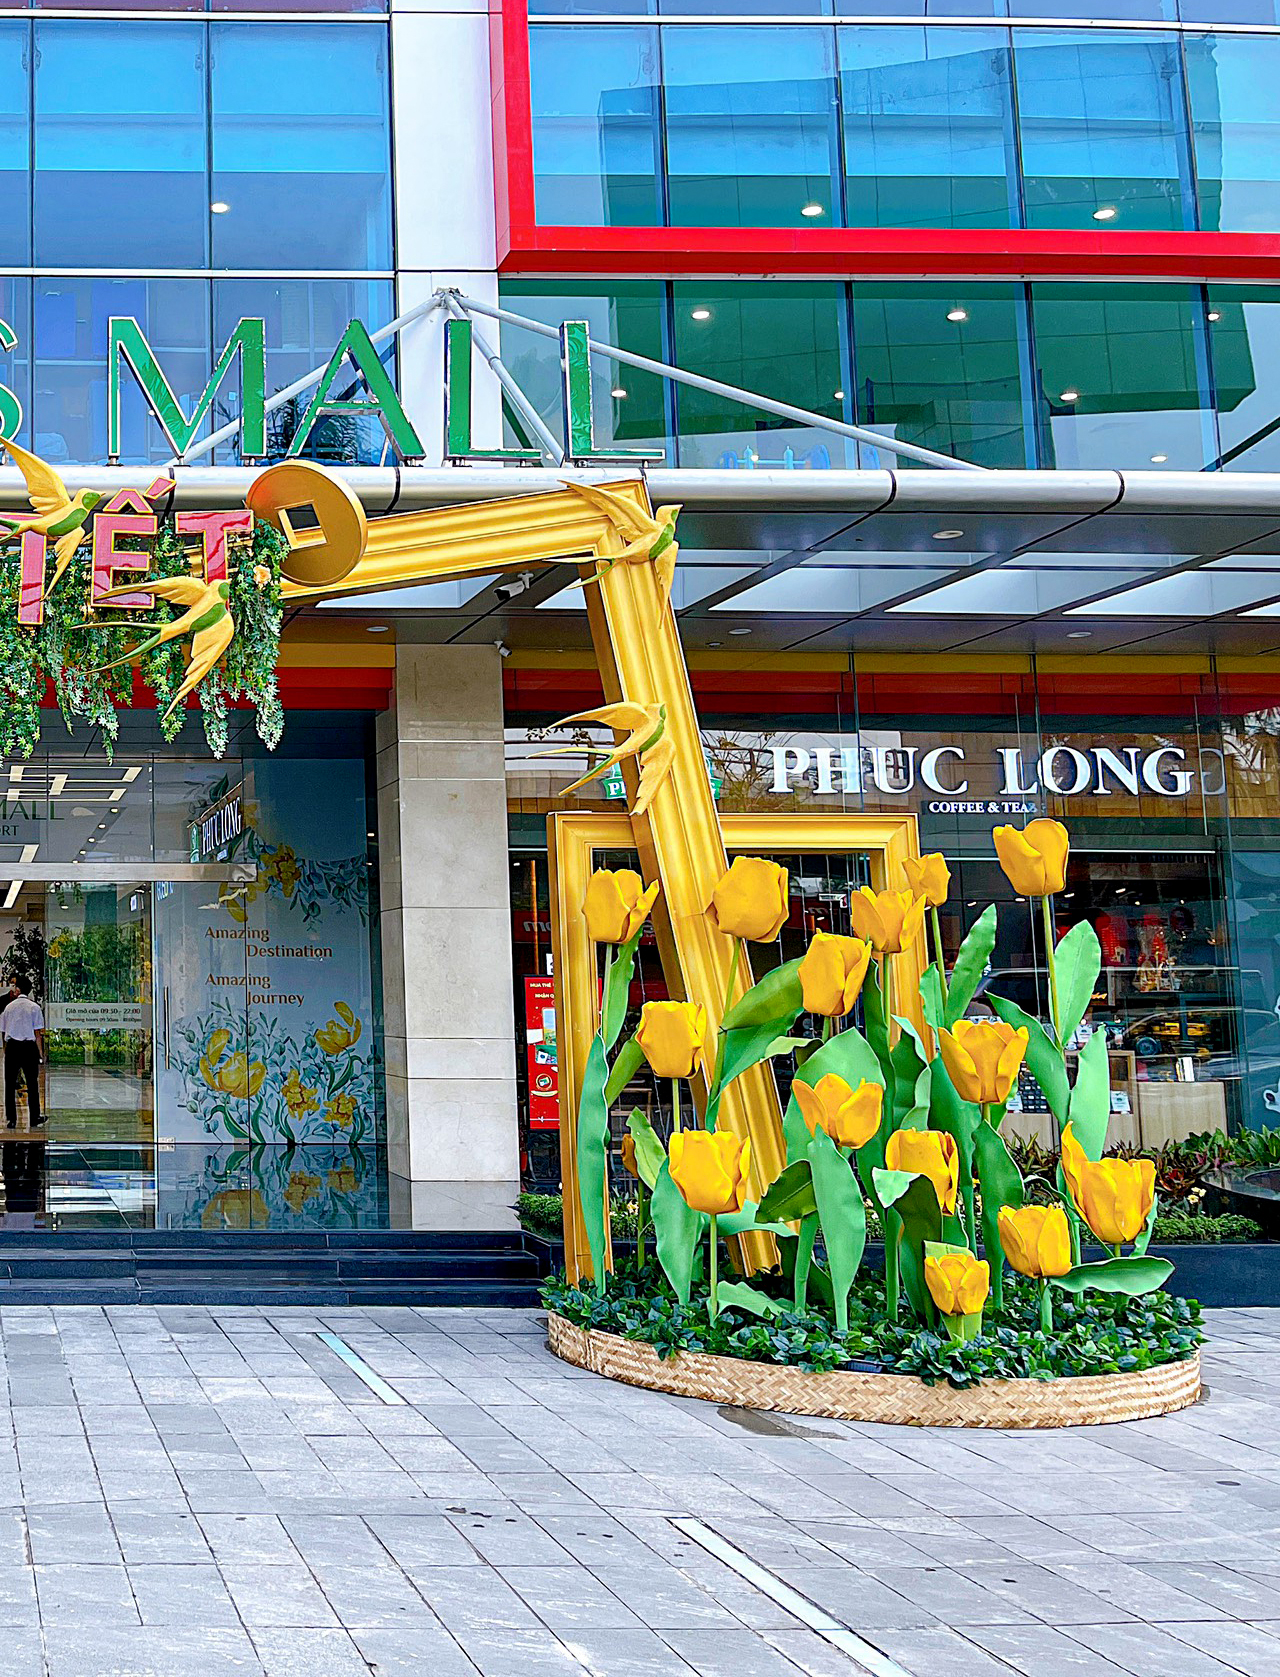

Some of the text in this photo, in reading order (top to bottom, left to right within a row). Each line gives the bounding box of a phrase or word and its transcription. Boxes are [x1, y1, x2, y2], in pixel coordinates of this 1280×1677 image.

[108, 317, 666, 461] MALL
[768, 746, 1195, 796] PHUC LONG
[929, 802, 985, 813] COFFEE
[987, 802, 1000, 813] &
[220, 797, 241, 844] LONG
[205, 926, 270, 943] Amazing
[246, 944, 333, 957] Destination
[205, 973, 271, 989] Amazing
[247, 991, 305, 1007] Journey
